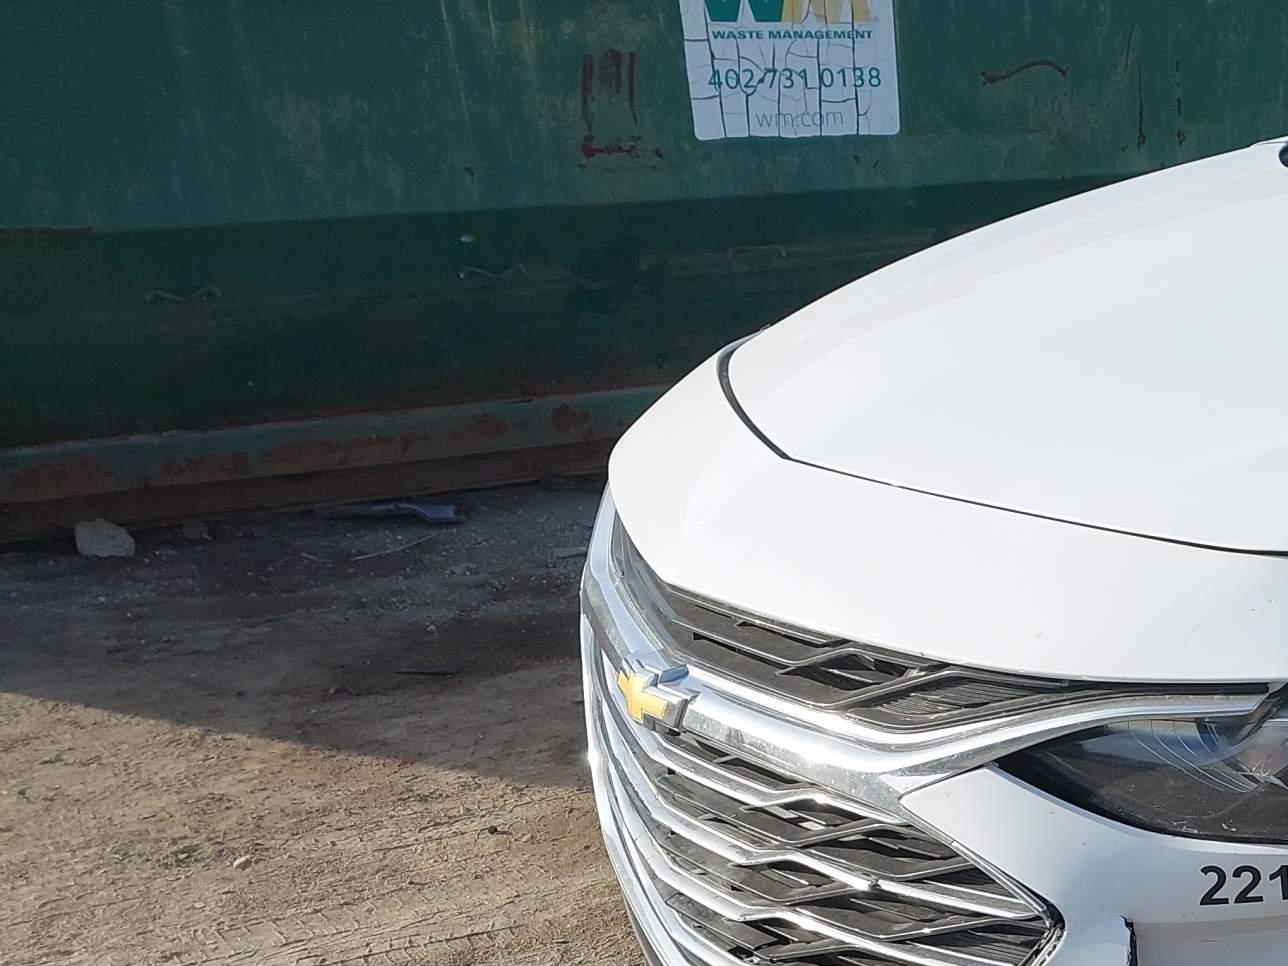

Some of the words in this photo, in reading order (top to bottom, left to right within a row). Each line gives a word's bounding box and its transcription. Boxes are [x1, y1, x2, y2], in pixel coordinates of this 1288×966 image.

[711, 30, 763, 39] WASTE
[768, 30, 872, 39] MANAGEMENT
[708, 68, 755, 90] 402
[763, 67, 812, 89] 731
[821, 66, 881, 88] 0138
[755, 111, 843, 128] wm.com
